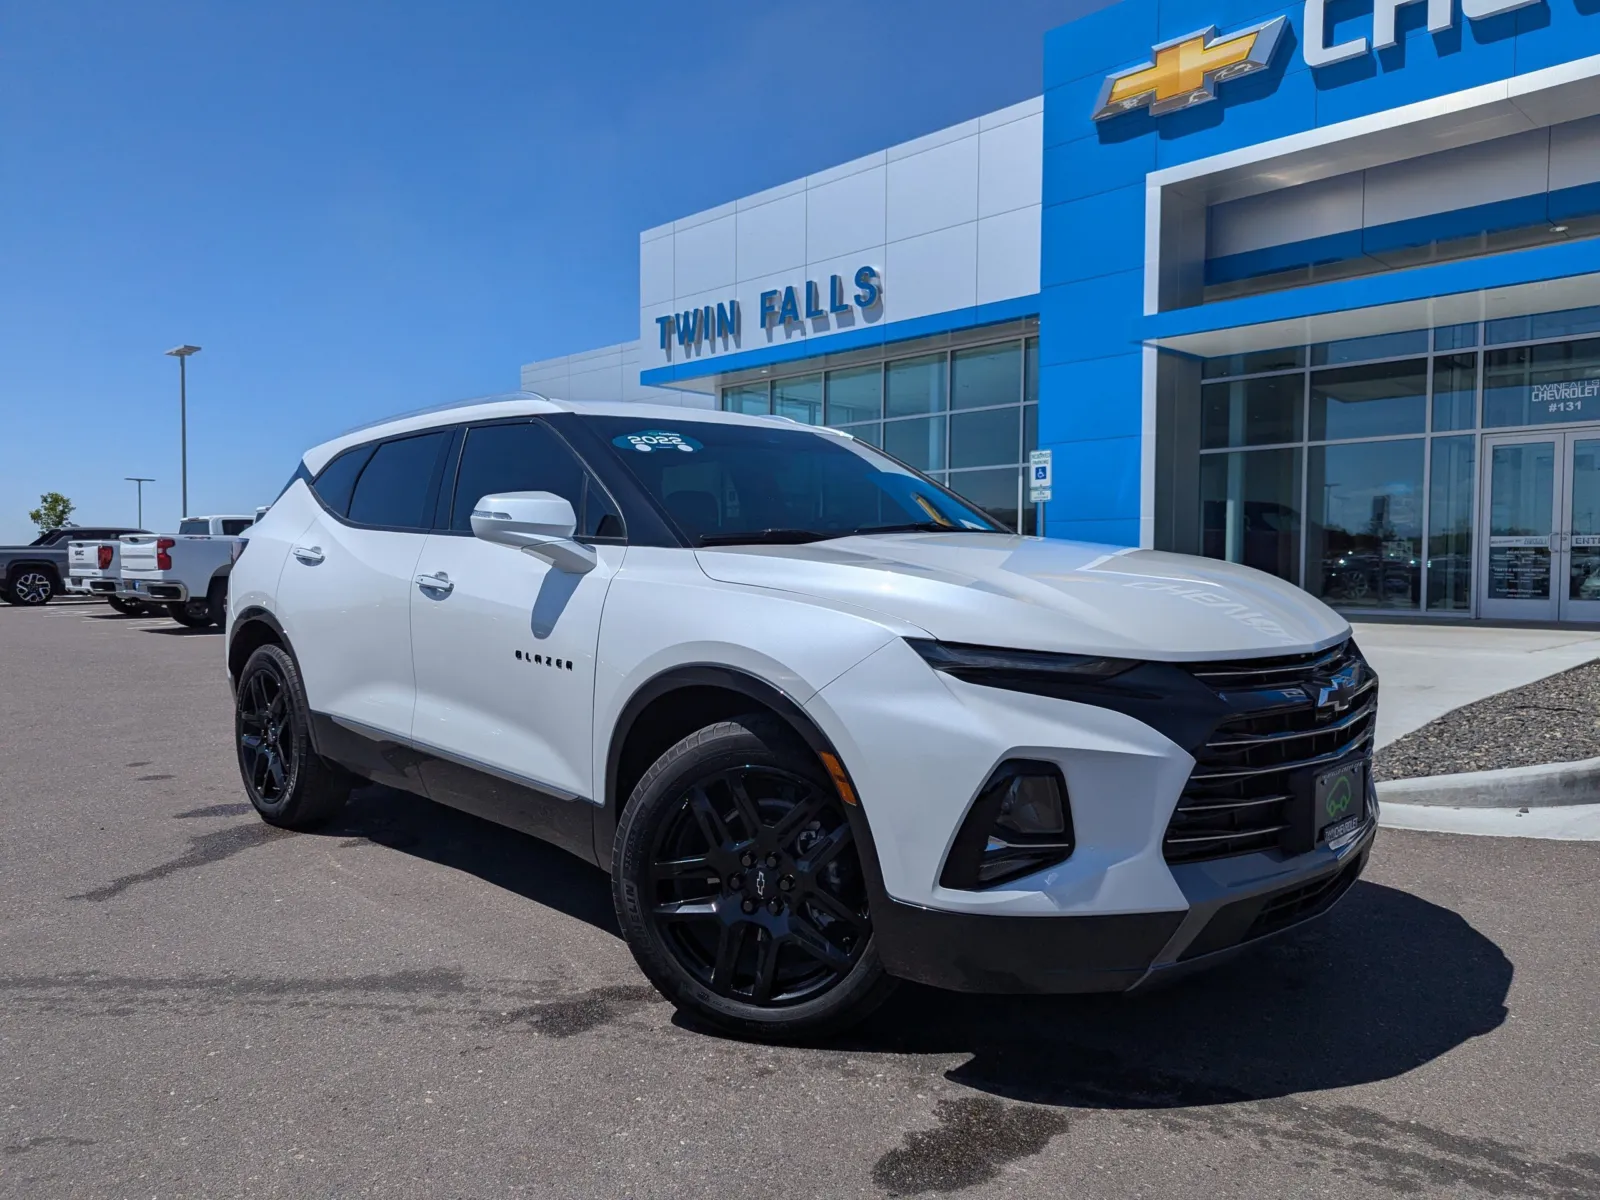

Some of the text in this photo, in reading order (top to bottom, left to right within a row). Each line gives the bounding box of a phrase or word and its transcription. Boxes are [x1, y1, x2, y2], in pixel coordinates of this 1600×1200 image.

[655, 266, 879, 349] TWIN FALLS
[1532, 386, 1600, 402] CHEVROLET
[1548, 401, 1582, 412] #131
[627, 435, 686, 445] 2022
[515, 649, 573, 671] BLAZER
